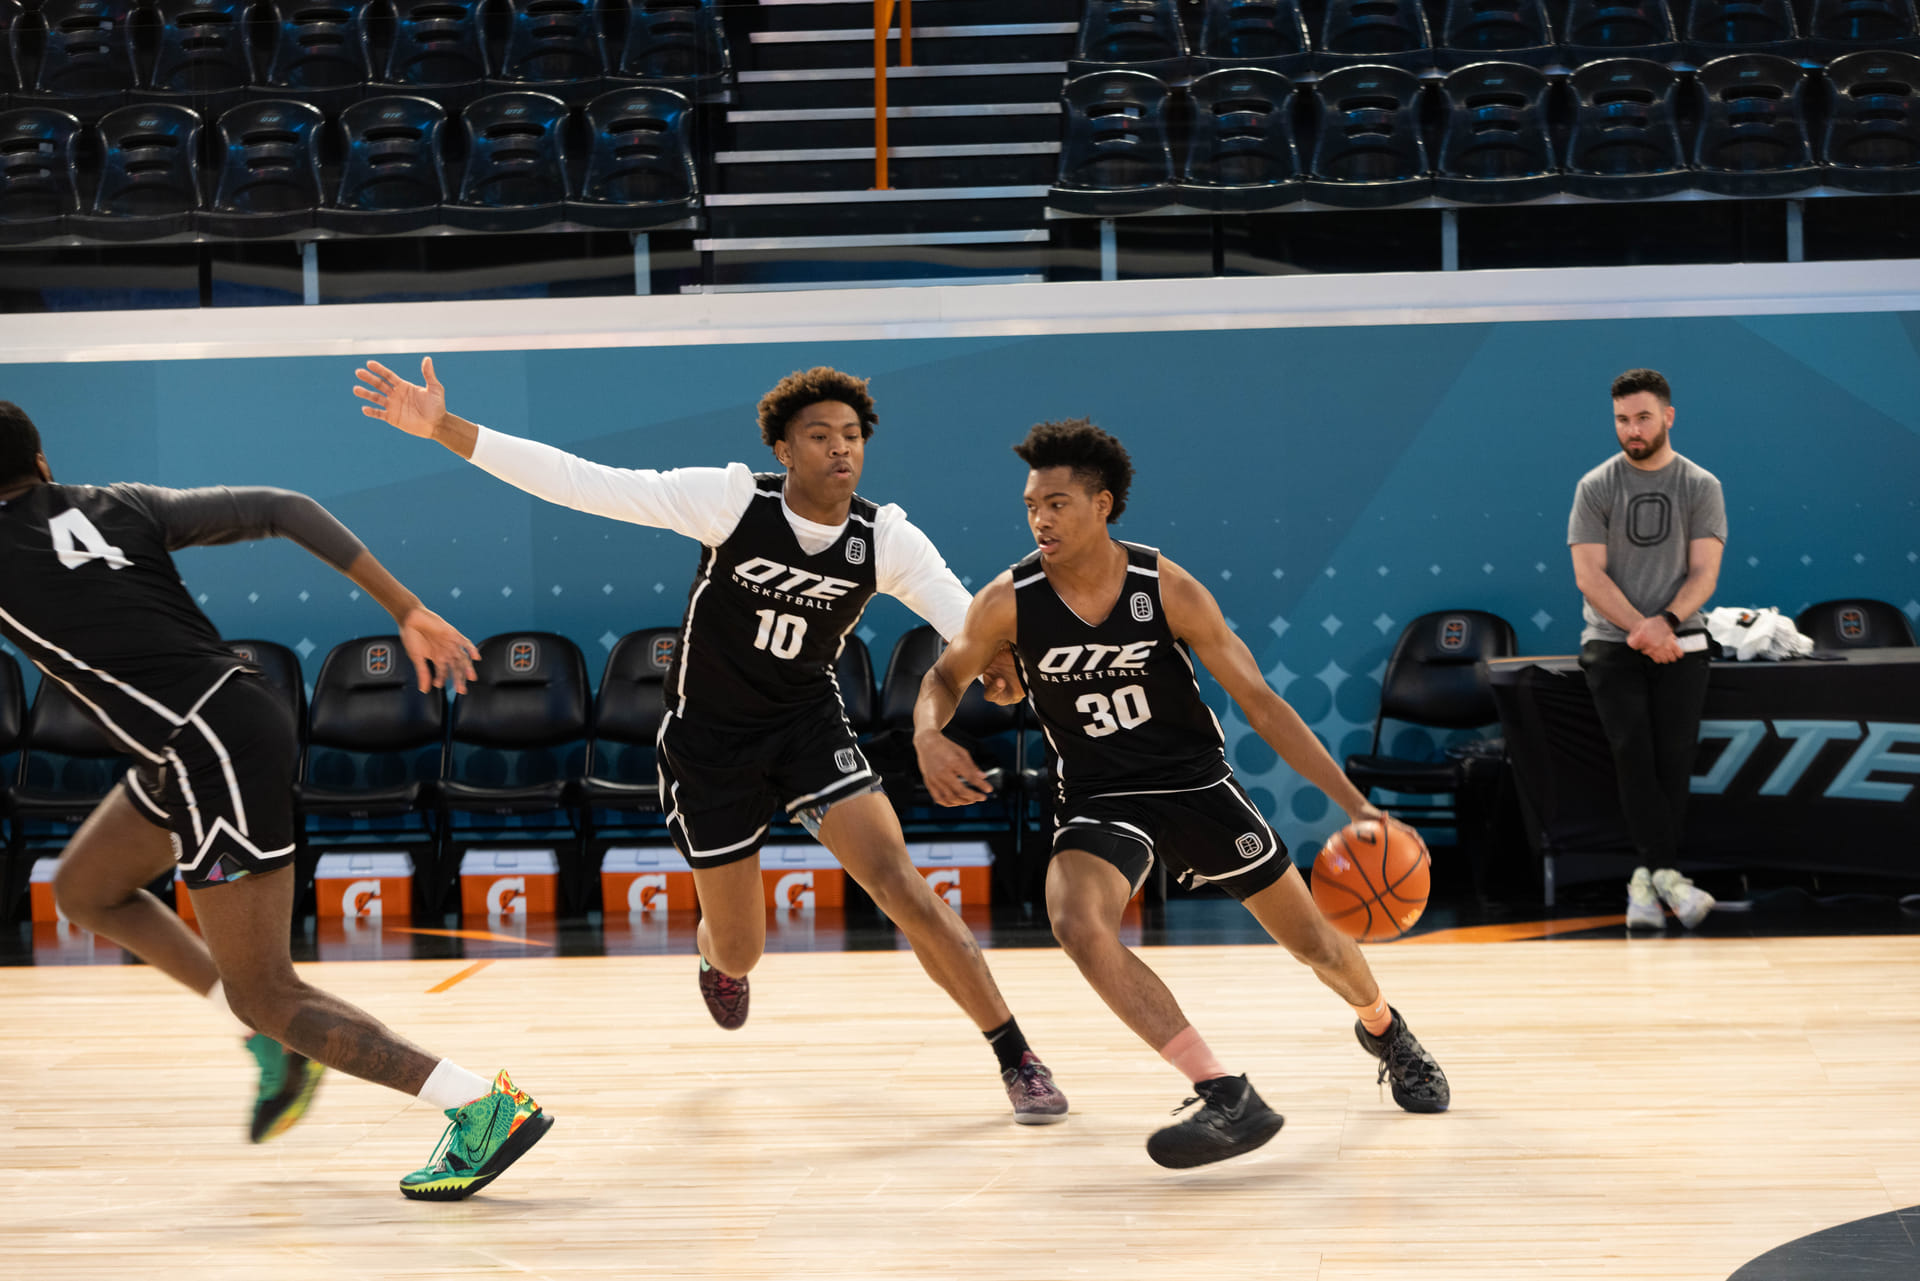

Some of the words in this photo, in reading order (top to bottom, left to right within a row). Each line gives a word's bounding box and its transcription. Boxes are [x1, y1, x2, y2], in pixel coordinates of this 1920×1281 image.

[49, 507, 134, 570] 4
[732, 574, 833, 611] BASKETBALL
[733, 556, 860, 601] OTE
[754, 608, 808, 660] 10
[1037, 640, 1158, 674] OTE
[1040, 669, 1149, 683] BASKETBALL
[1075, 684, 1152, 738] 30
[342, 879, 383, 917] G
[486, 877, 527, 915] G
[627, 873, 669, 912] G
[774, 871, 816, 910] G
